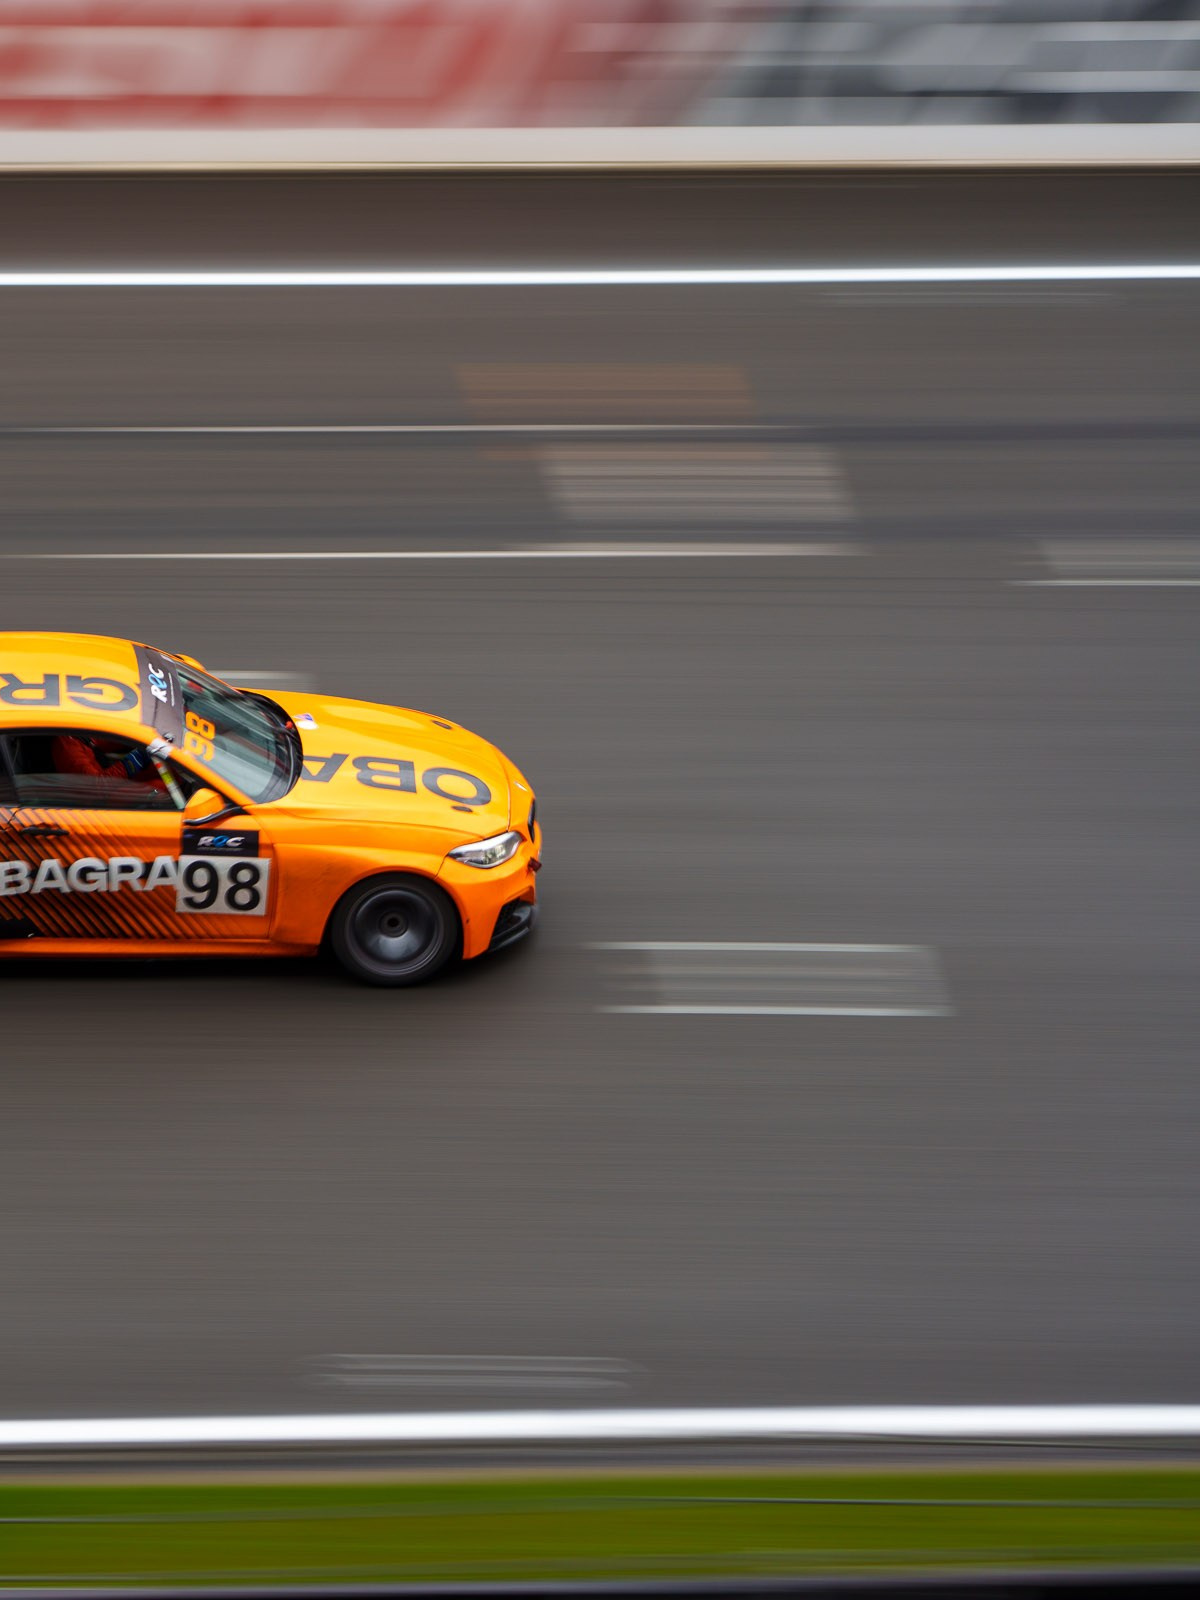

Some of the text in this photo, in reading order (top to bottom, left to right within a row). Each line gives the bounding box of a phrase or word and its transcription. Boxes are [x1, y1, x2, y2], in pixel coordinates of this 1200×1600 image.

[184, 711, 216, 762] 98
[301, 752, 492, 806] OBA
[183, 860, 261, 911] 98
